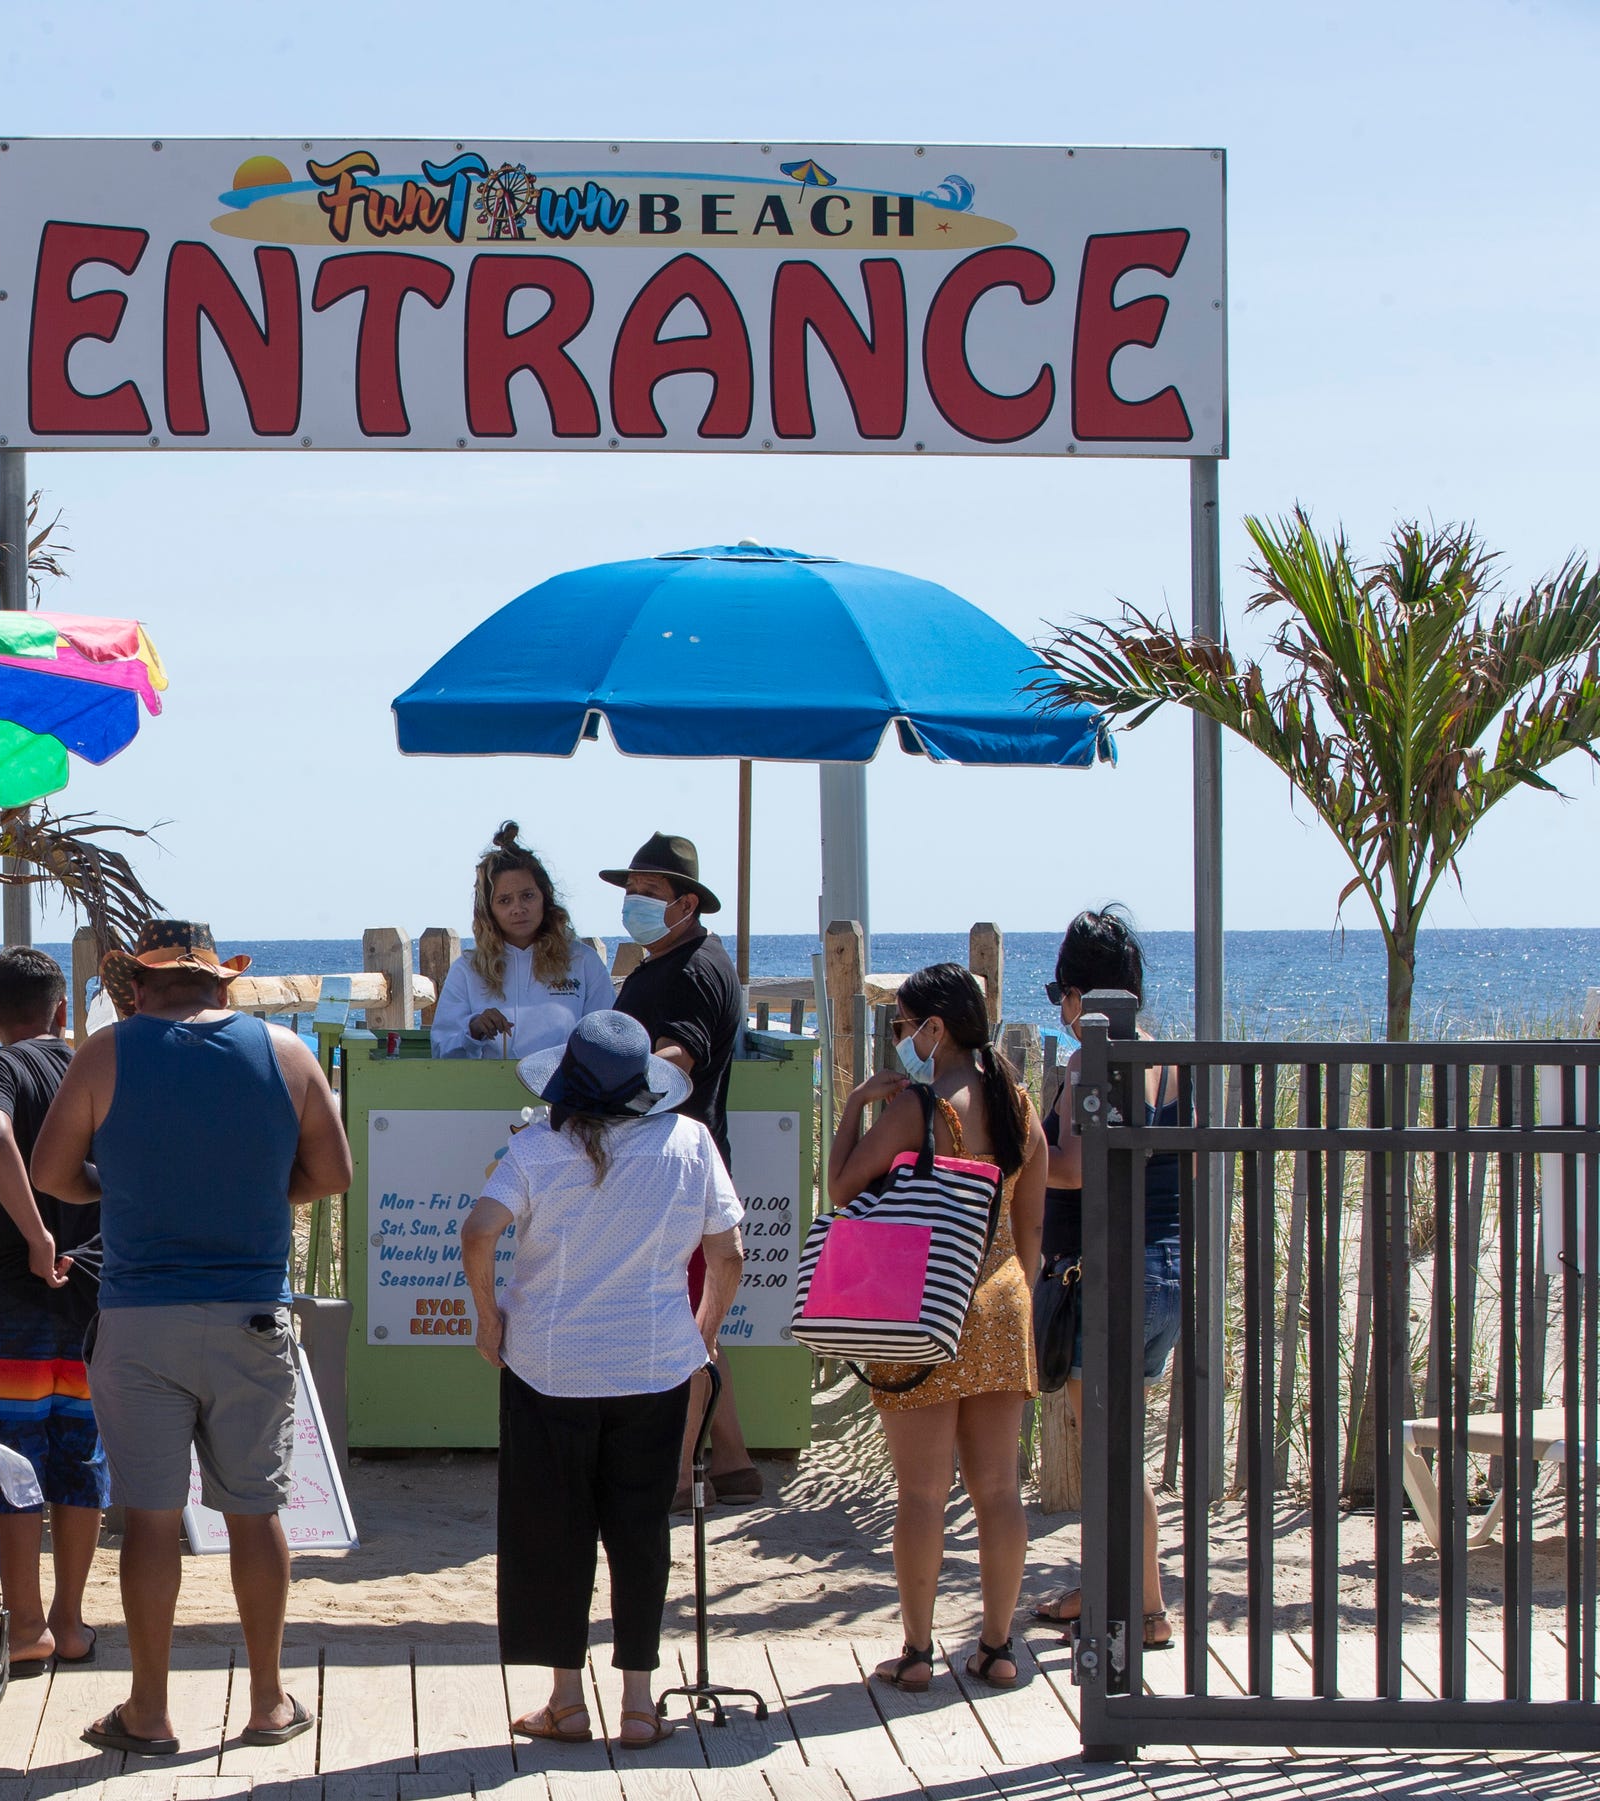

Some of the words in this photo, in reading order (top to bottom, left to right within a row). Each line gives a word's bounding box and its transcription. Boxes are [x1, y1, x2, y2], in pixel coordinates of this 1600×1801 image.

[639, 193, 915, 237] BEACH
[27, 223, 1194, 443] ENTRANCE
[379, 1193, 414, 1210] Mon
[429, 1194, 451, 1210] Fri
[740, 1196, 790, 1211] 10.00
[379, 1219, 406, 1236] Sat,
[410, 1219, 441, 1237] Sun,
[445, 1220, 457, 1235] &
[739, 1222, 791, 1236] 12.00
[379, 1245, 438, 1264] Weekly
[379, 1270, 451, 1287] Seasonal
[416, 1299, 466, 1316] BYOB
[410, 1318, 472, 1336] BEACH
